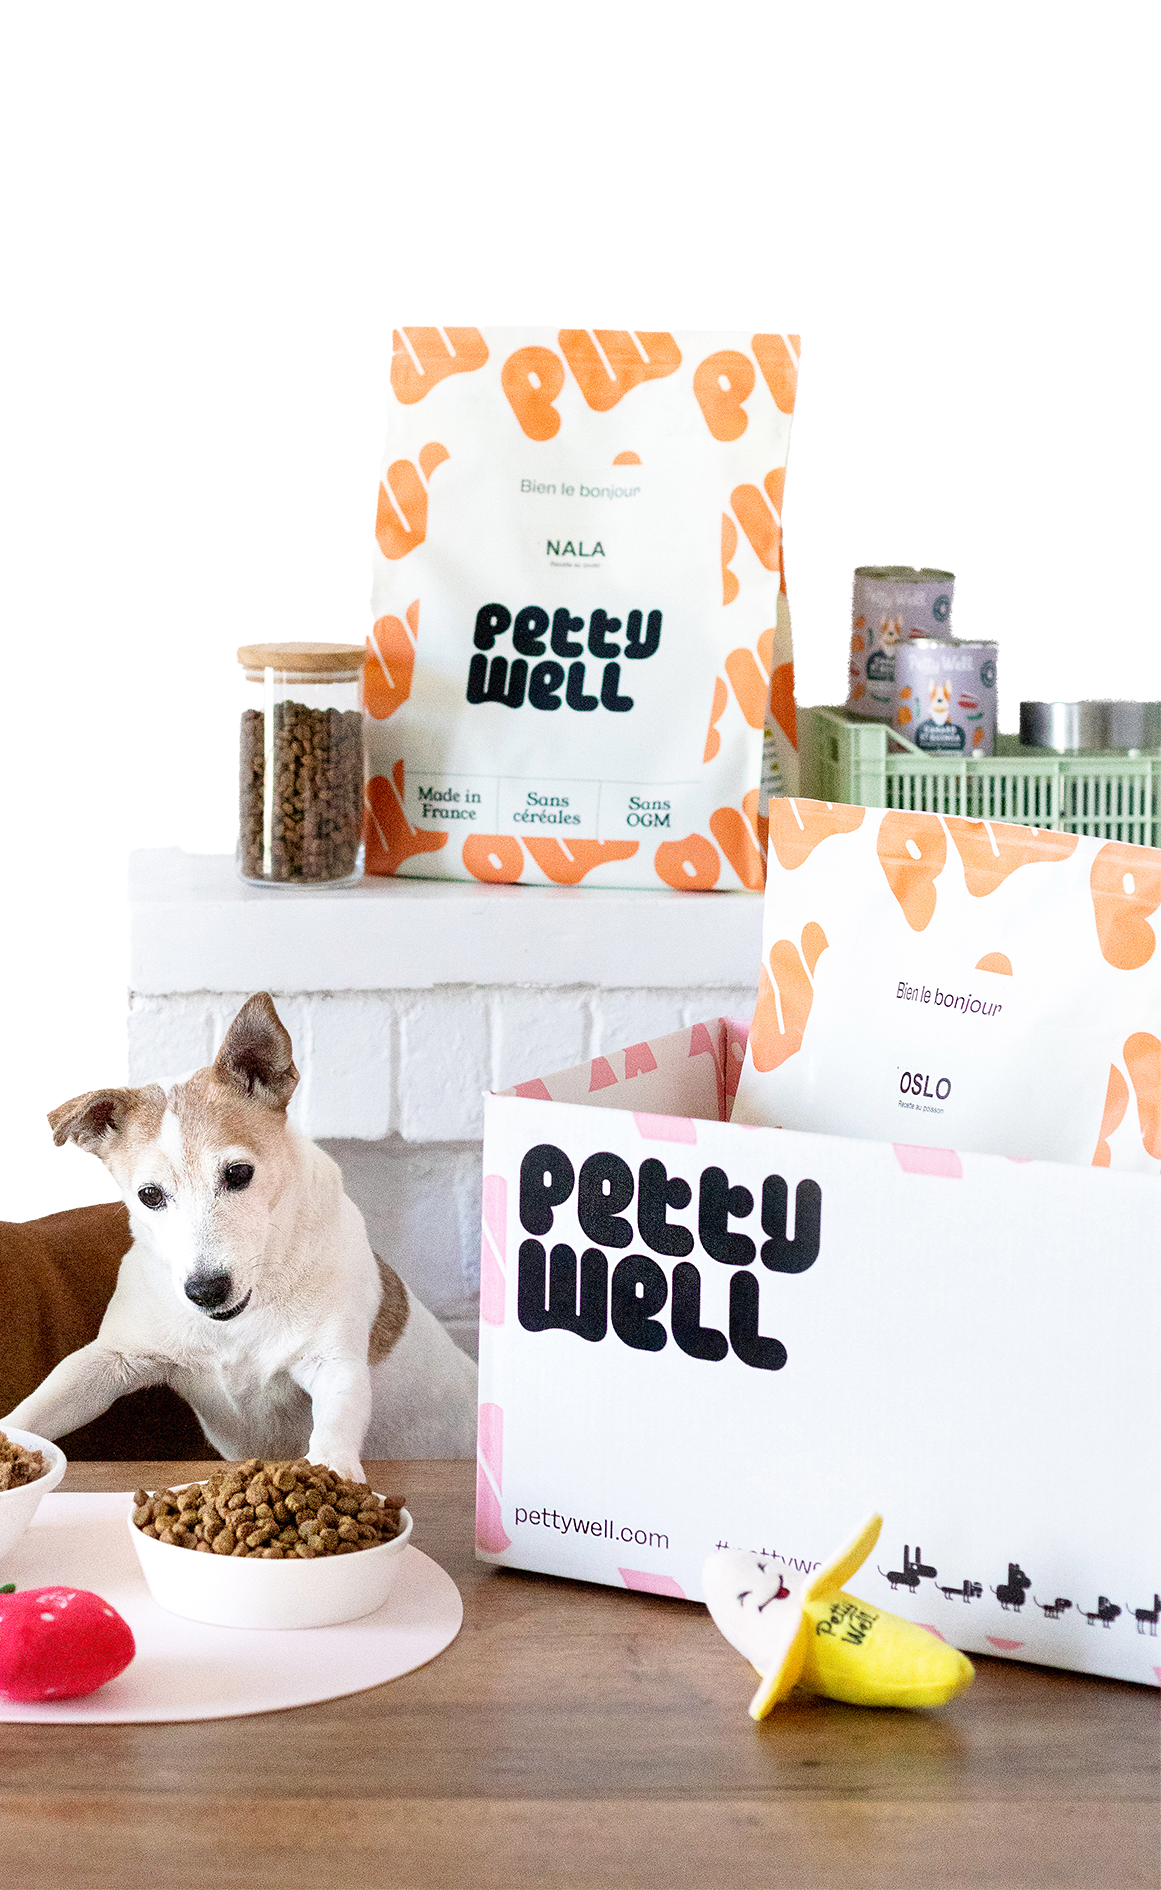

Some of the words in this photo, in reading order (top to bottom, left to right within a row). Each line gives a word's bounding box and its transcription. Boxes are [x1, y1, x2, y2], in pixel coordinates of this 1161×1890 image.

[520, 478, 557, 495] Bien
[561, 482, 576, 497] le
[579, 483, 642, 501] bonjour
[546, 539, 606, 558] NALA
[417, 786, 461, 803] Made
[465, 789, 481, 804] in
[526, 791, 570, 808] Sans
[628, 796, 672, 812] Sans
[422, 803, 477, 821] France
[512, 809, 582, 826] céréales
[626, 812, 672, 828] OGM
[896, 981, 919, 1002] Bien
[919, 985, 932, 1004] le
[933, 987, 1003, 1017] bonjour
[899, 1071, 952, 1100] OSLO
[922, 1105, 945, 1115] poisson
[514, 1506, 670, 1550] pettywell.com
